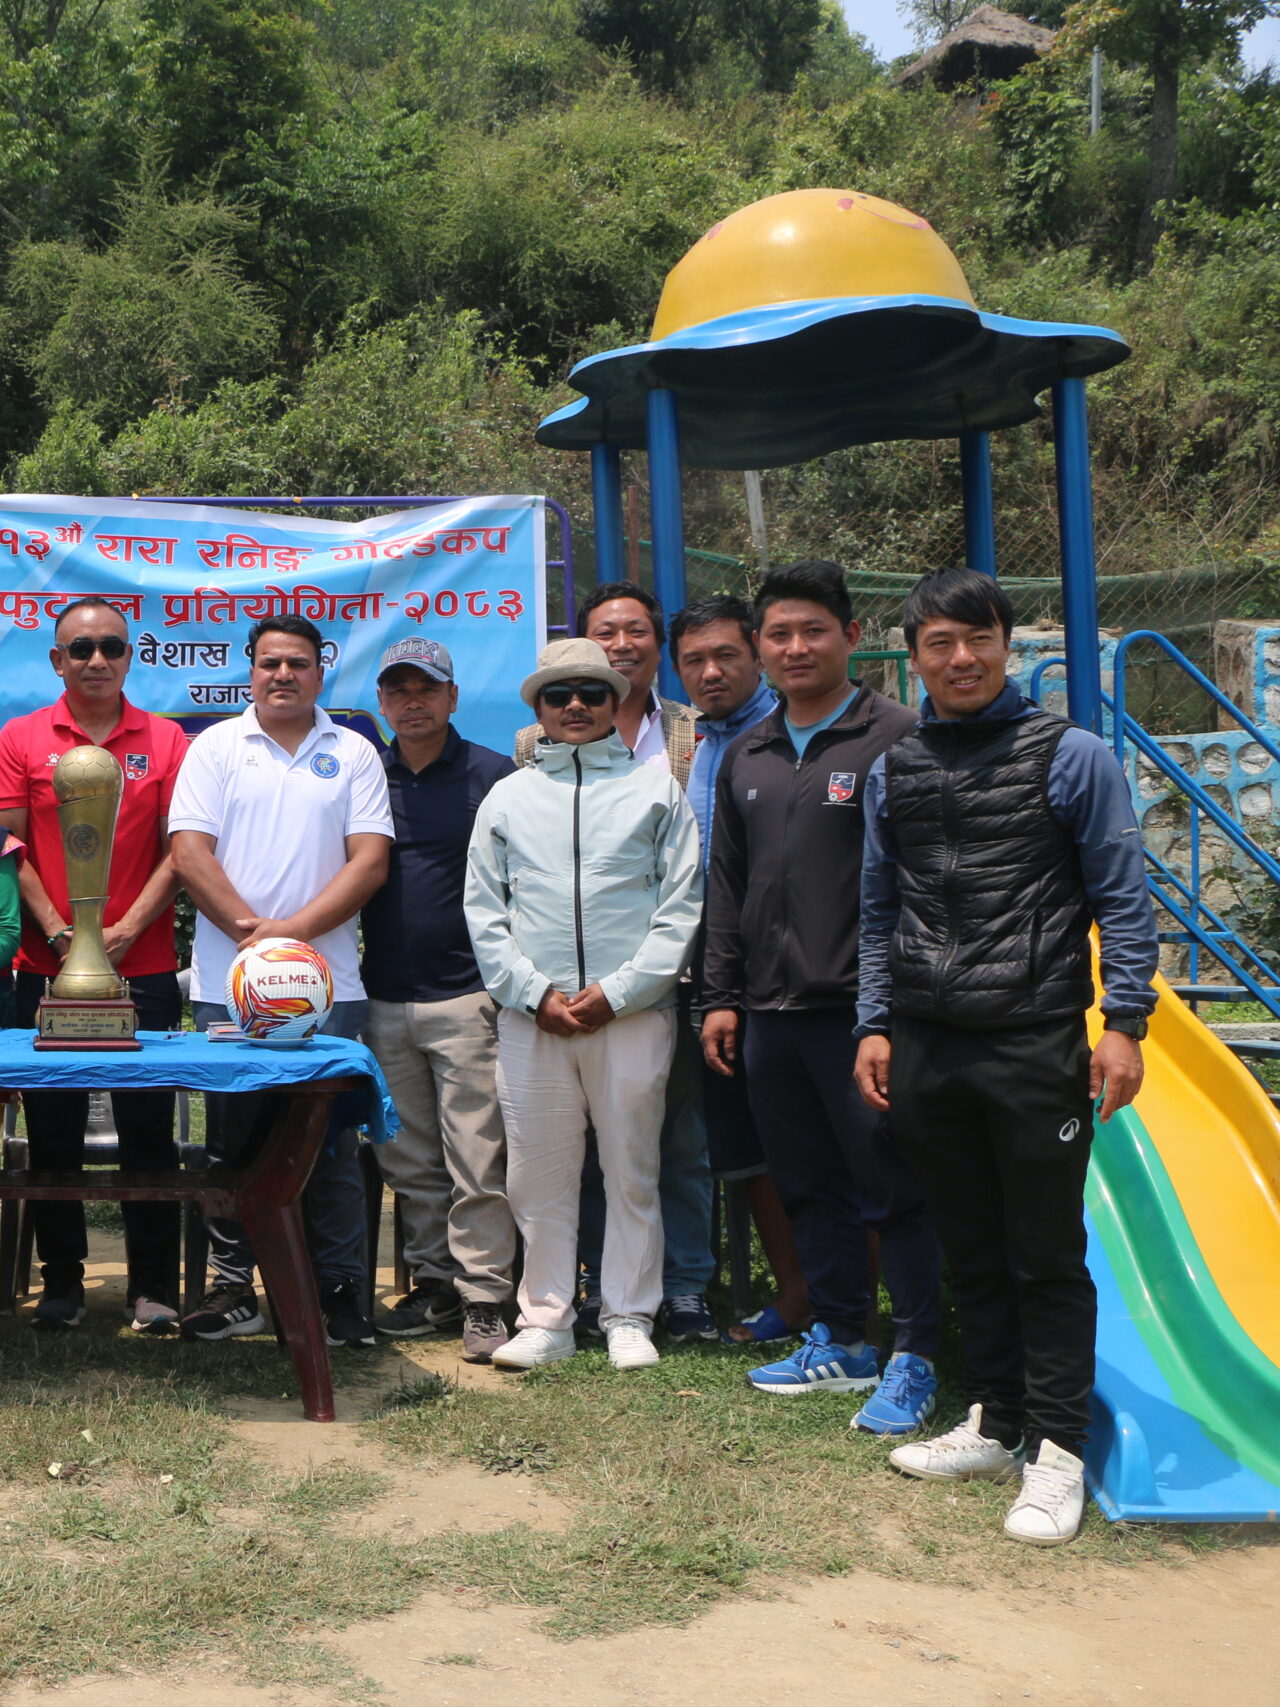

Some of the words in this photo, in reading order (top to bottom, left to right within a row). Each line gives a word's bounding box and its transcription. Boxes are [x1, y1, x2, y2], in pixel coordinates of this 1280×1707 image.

[94, 534, 179, 565] रारा
[138, 633, 230, 668] बैशाख
[257, 974, 309, 987] KELME
